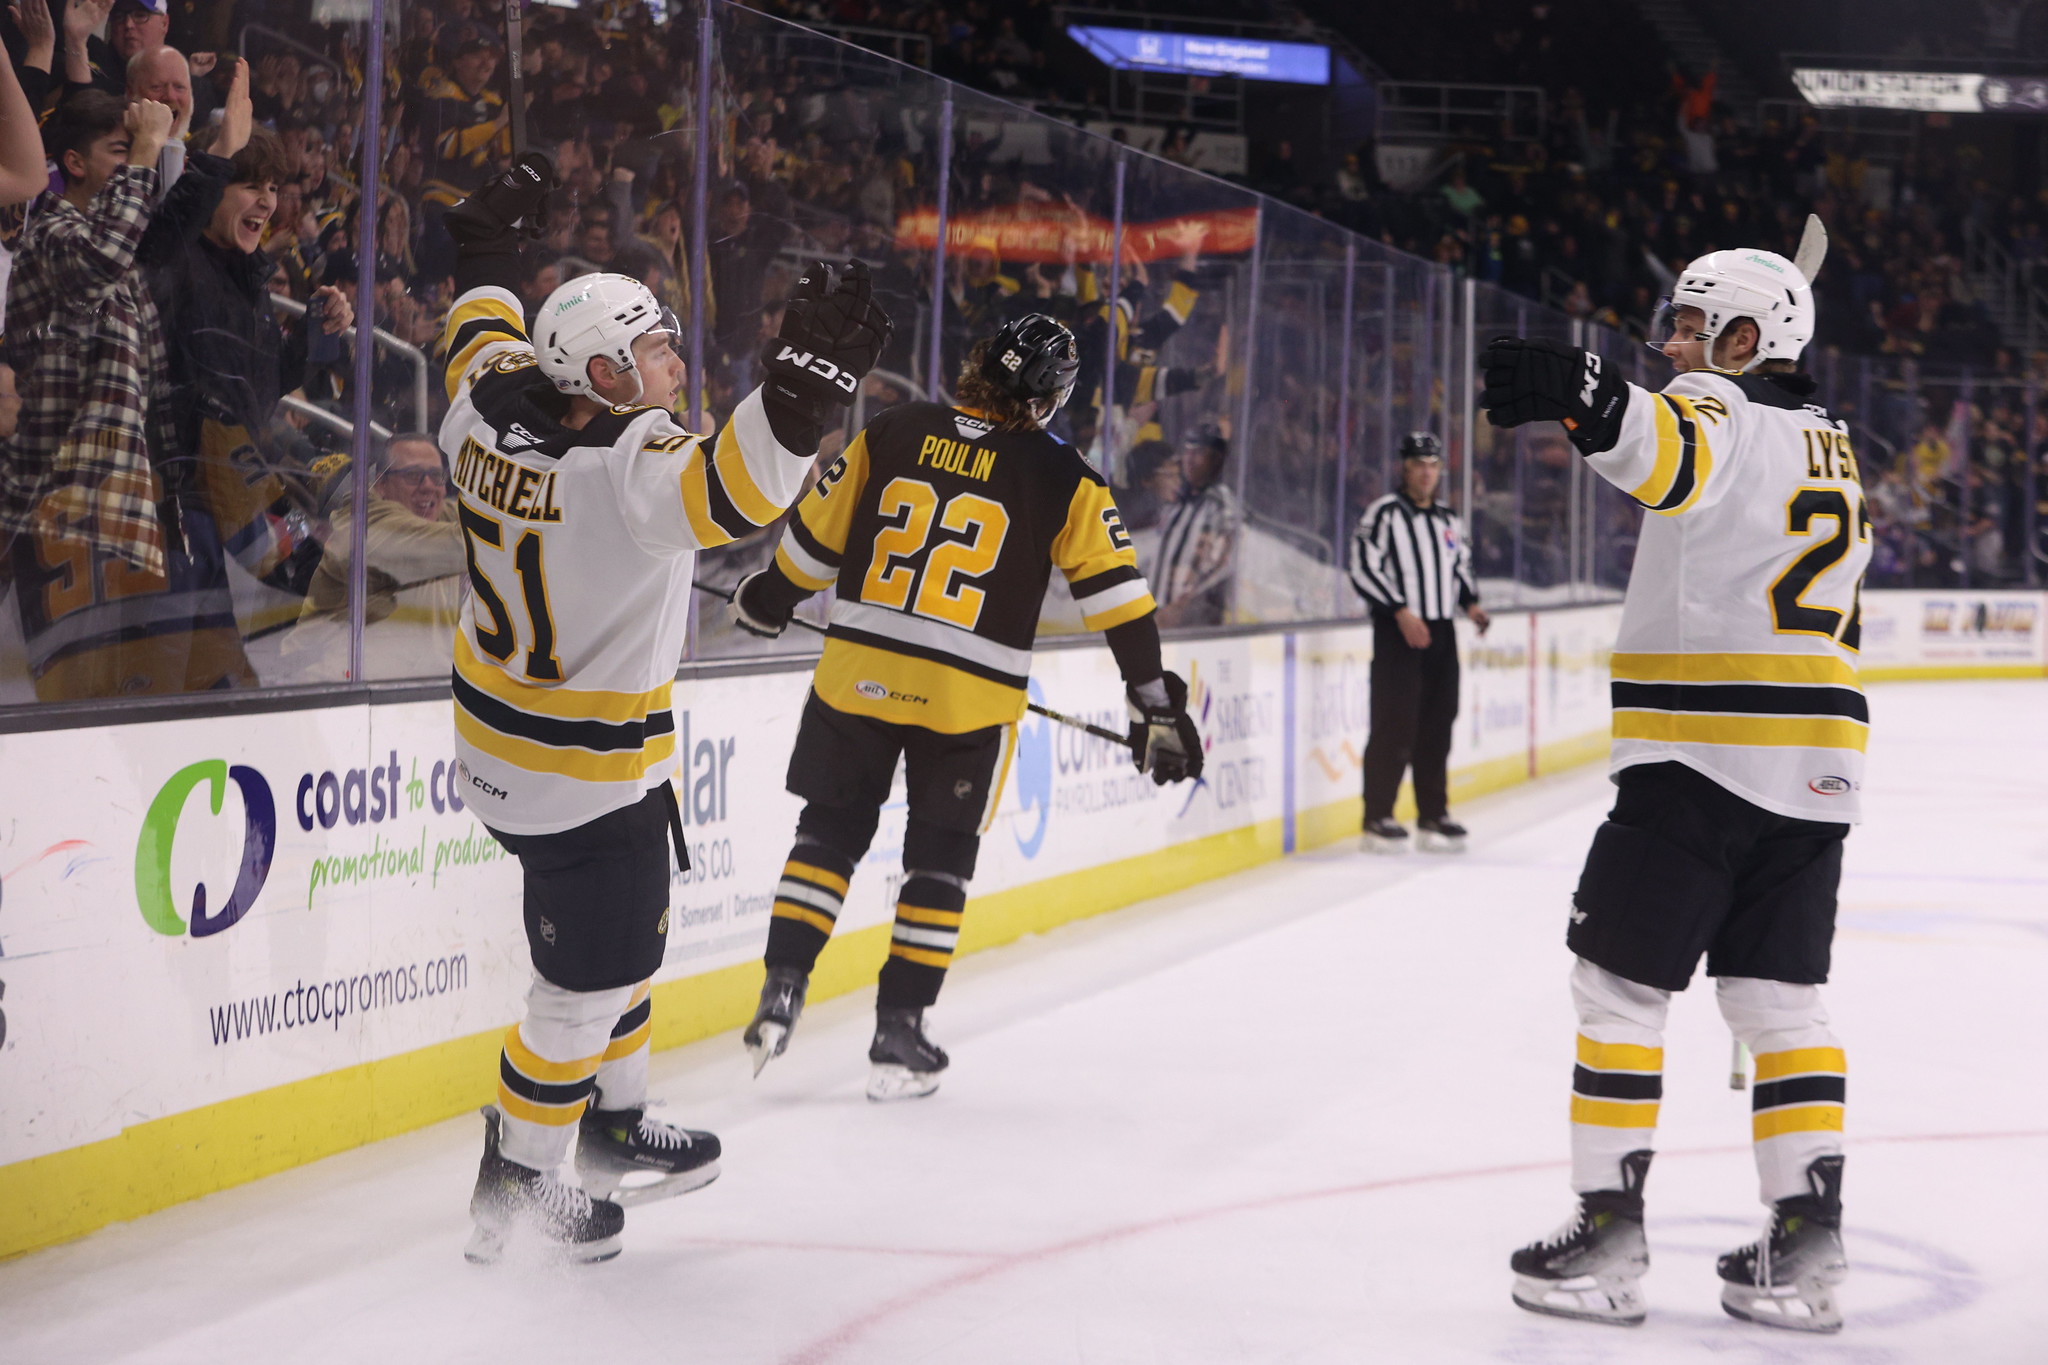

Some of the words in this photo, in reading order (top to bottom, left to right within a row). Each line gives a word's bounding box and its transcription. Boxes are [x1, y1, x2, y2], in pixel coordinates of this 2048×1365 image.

[775, 345, 857, 393] CCM
[1000, 349, 1023, 372] 22
[917, 434, 998, 482] POULIN
[953, 415, 996, 432] CCM
[1803, 429, 1861, 484] LYS
[454, 434, 563, 523] MITCHELL
[458, 496, 567, 682] 51
[860, 476, 1011, 632] 22
[889, 691, 929, 705] CCM
[682, 710, 736, 827] lar
[1056, 706, 1133, 776] COMPL
[296, 750, 401, 832] coast
[406, 756, 425, 813] to
[472, 776, 508, 800] CCM
[308, 825, 426, 911] promotional
[209, 953, 468, 1046] www.ctocpromos.com
